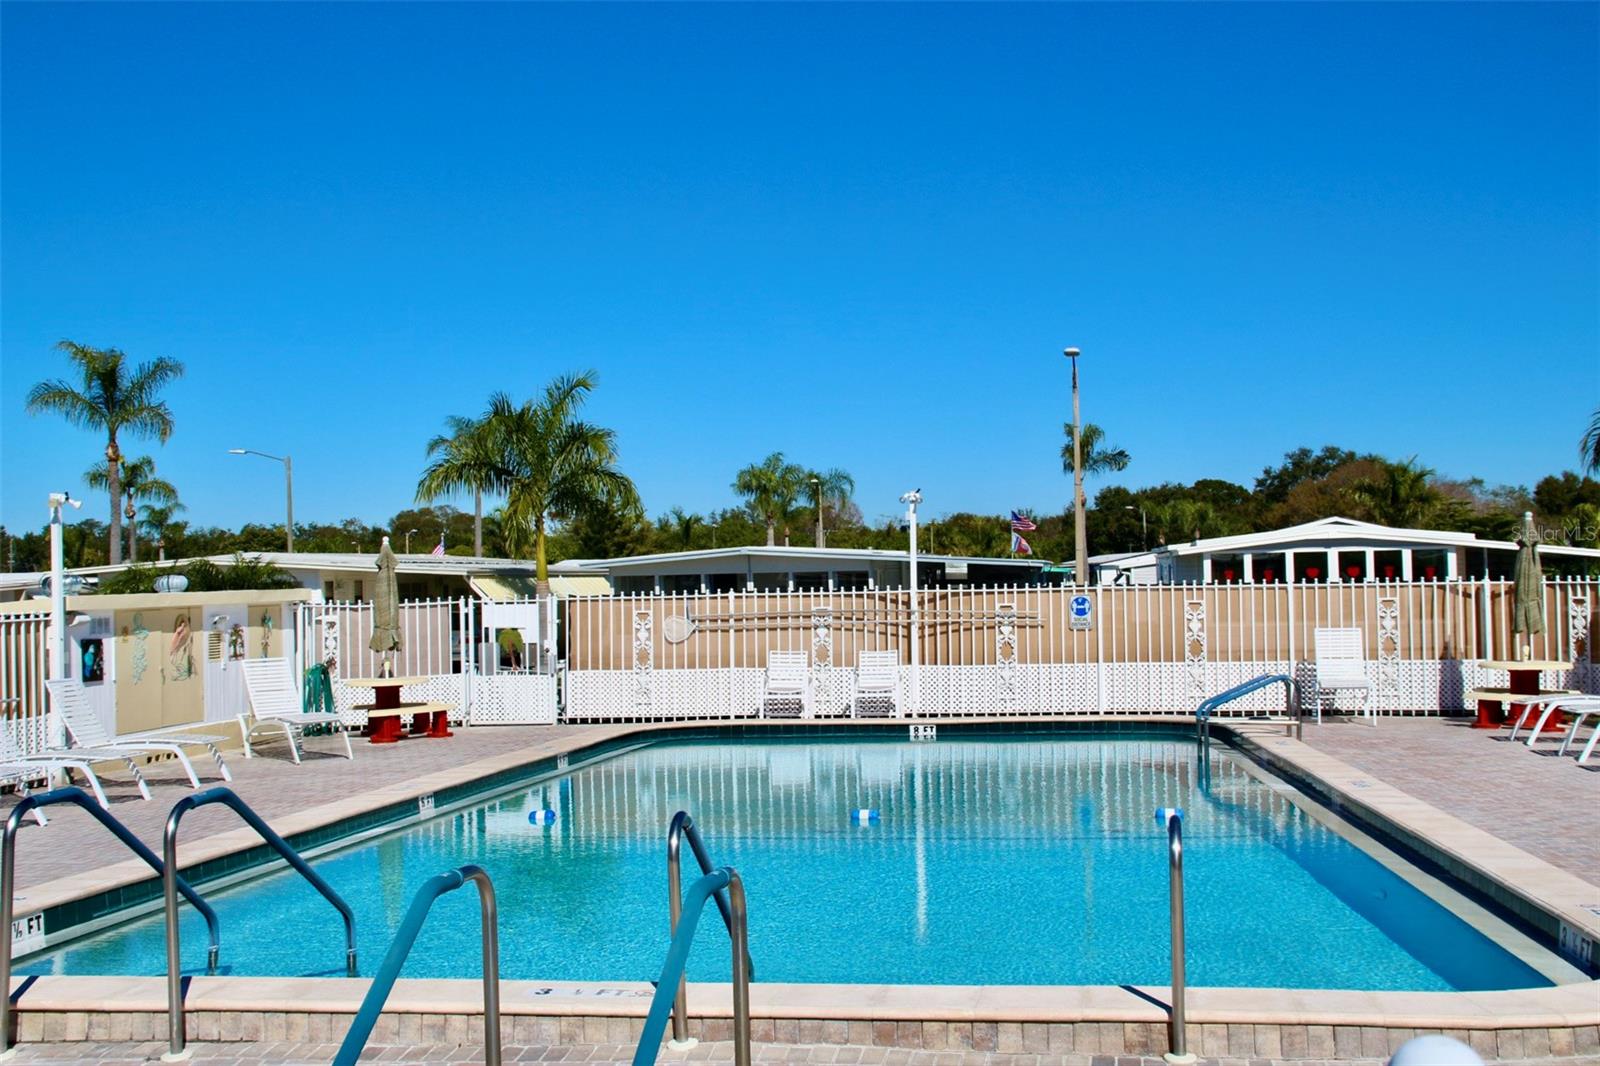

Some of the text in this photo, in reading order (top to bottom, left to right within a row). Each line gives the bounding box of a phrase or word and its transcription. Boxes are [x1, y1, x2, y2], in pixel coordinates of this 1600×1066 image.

[913, 725, 934, 736] 8 FT
[27, 914, 42, 935] FT
